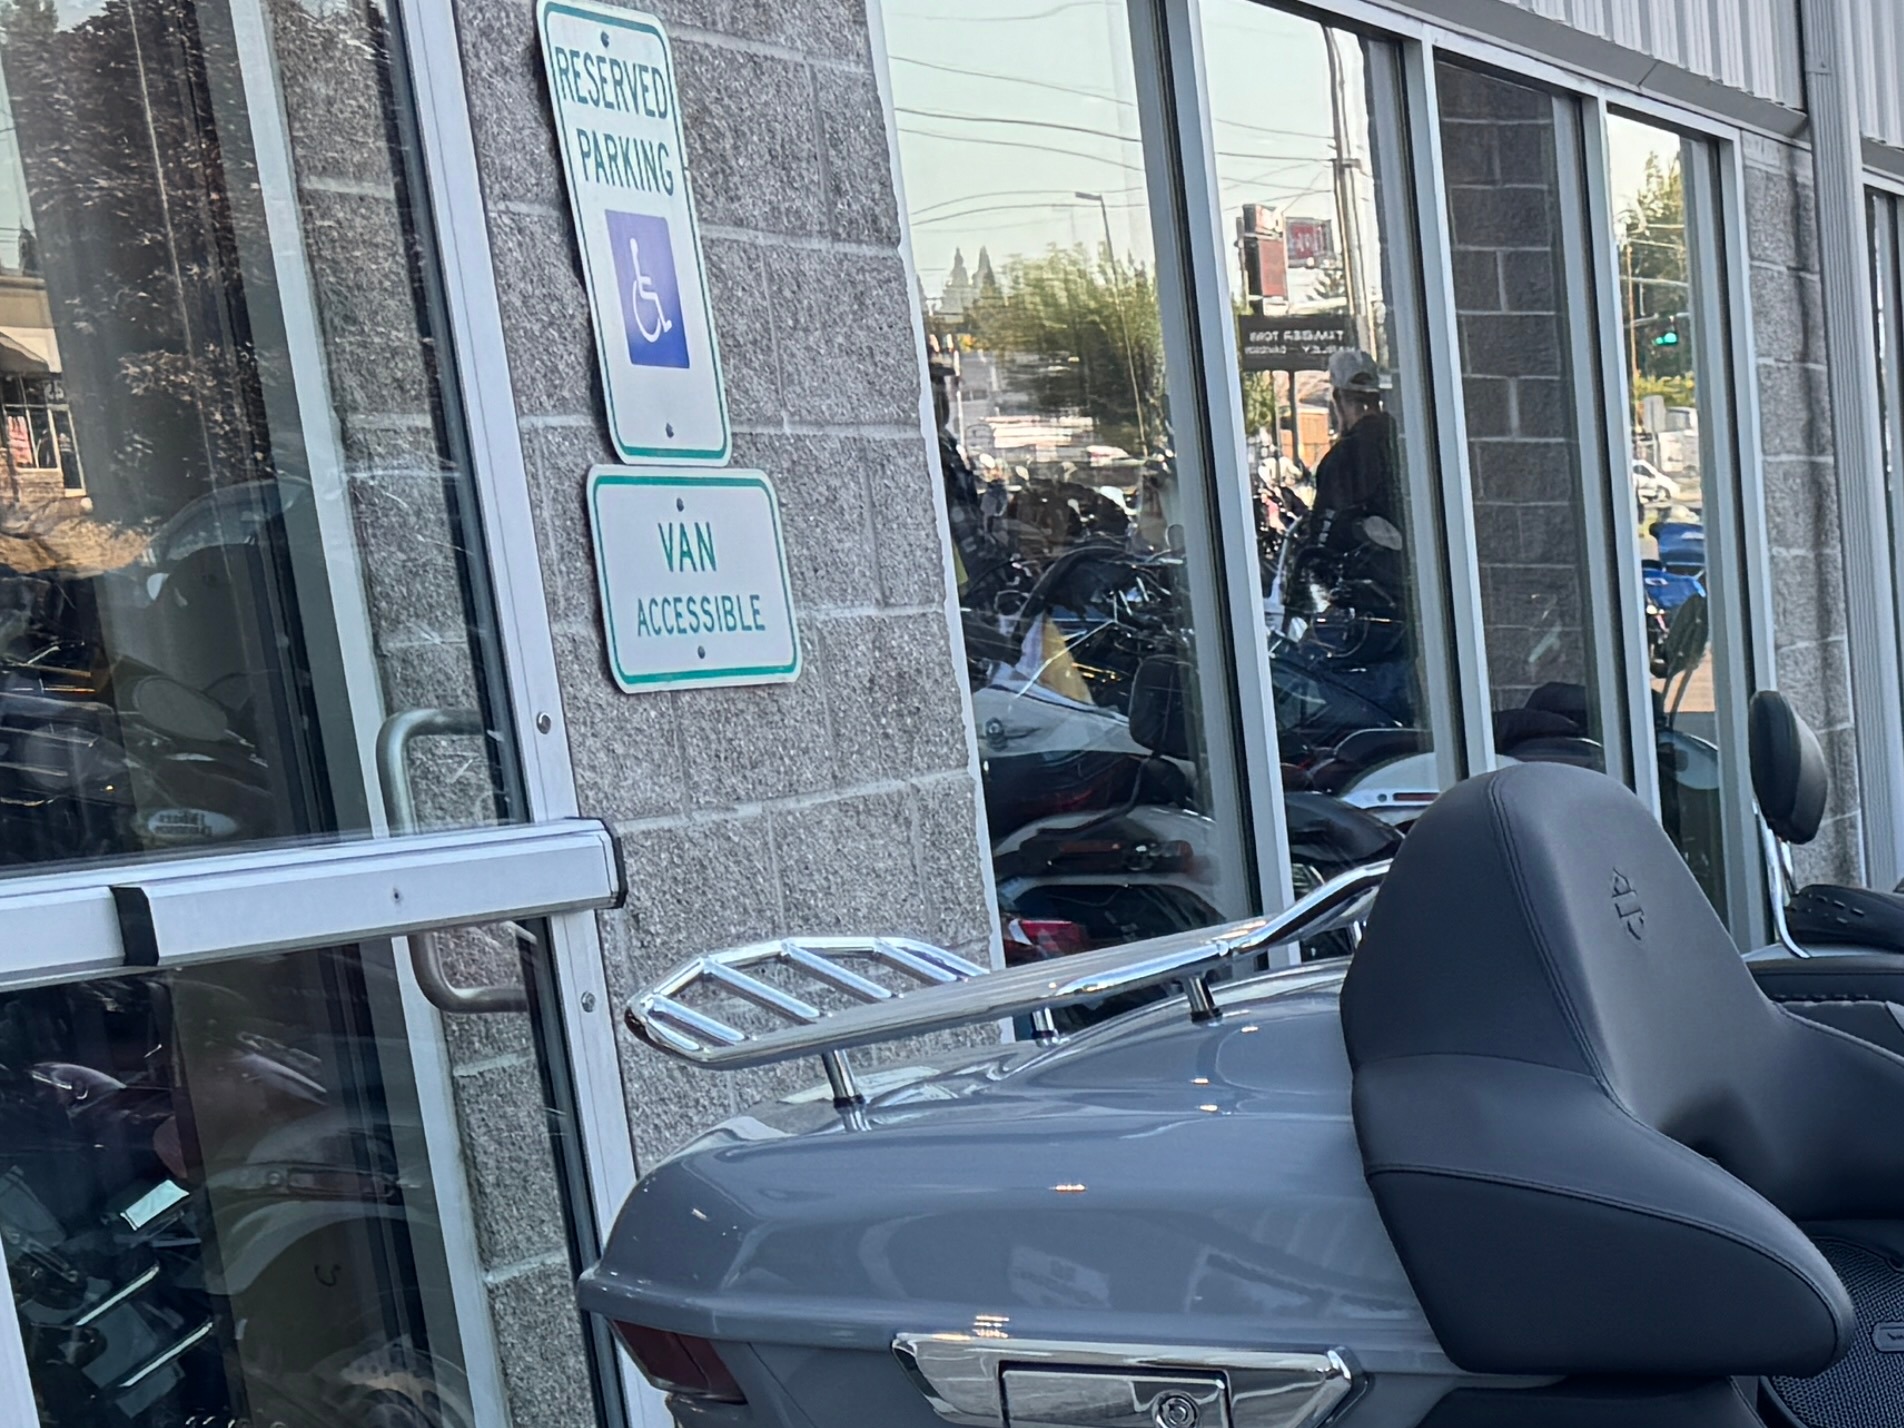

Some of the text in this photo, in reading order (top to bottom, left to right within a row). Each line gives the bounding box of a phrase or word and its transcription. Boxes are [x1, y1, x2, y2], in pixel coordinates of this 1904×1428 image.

[555, 46, 669, 120] RESERVED
[576, 128, 675, 196] PARKING
[659, 520, 717, 573] VAN
[637, 593, 766, 638] ACCESSIBLE
